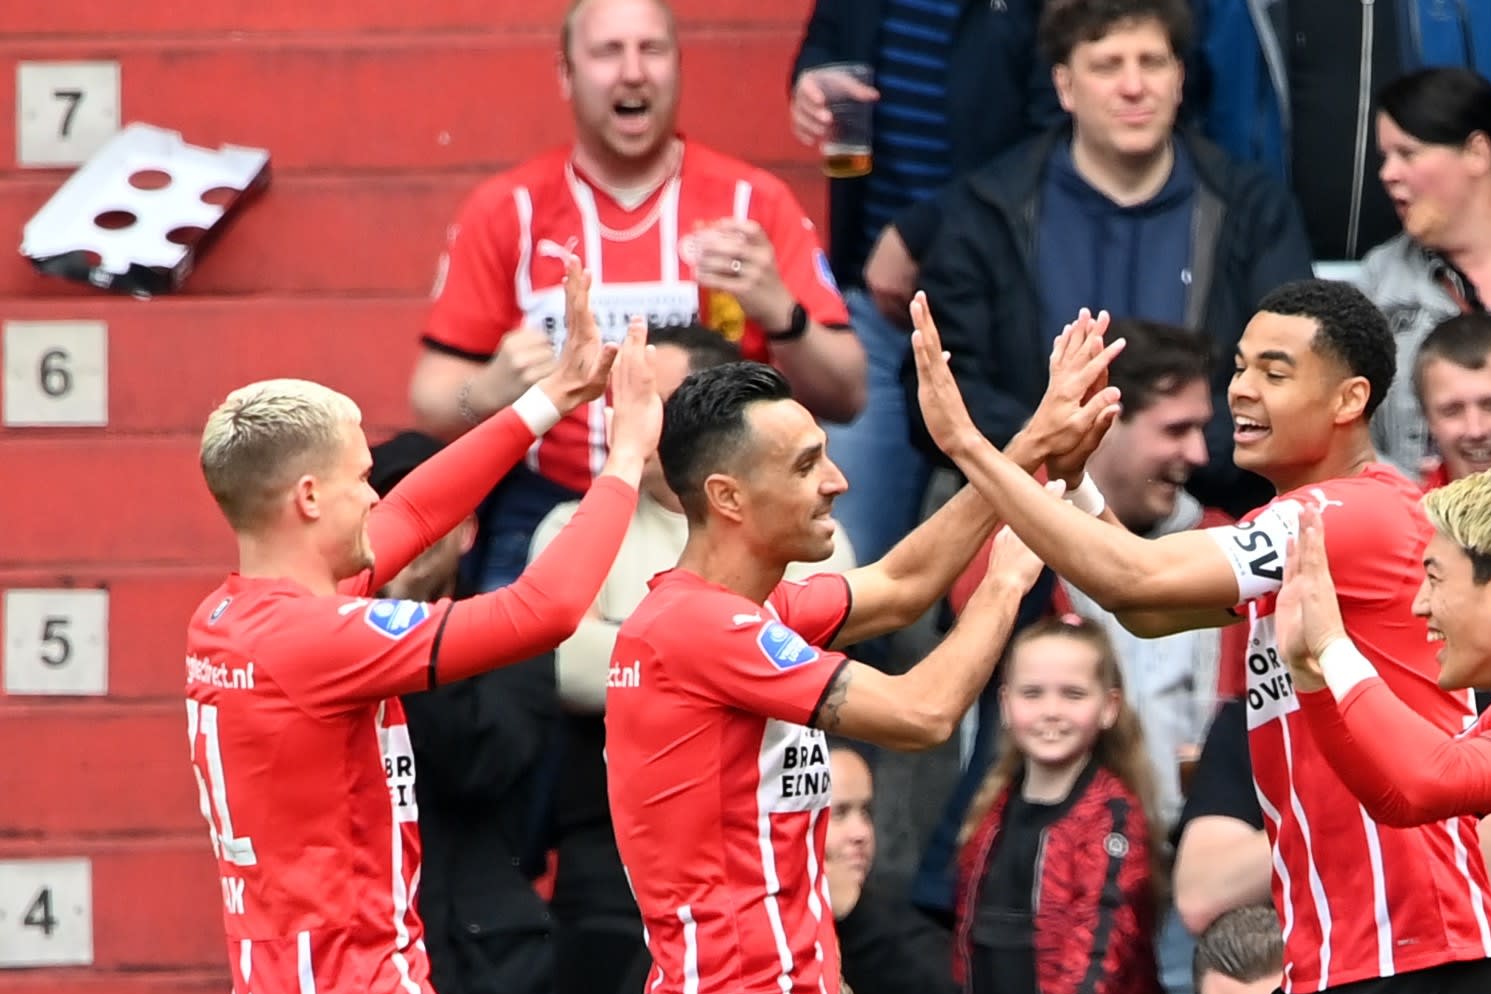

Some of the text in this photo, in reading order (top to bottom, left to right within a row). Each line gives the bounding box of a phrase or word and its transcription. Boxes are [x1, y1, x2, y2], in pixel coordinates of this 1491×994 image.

[54, 91, 84, 137] 7
[40, 349, 73, 396] 6
[40, 619, 71, 667] 5
[186, 698, 257, 867] 1
[384, 756, 412, 778] BR
[23, 887, 57, 935] 4
